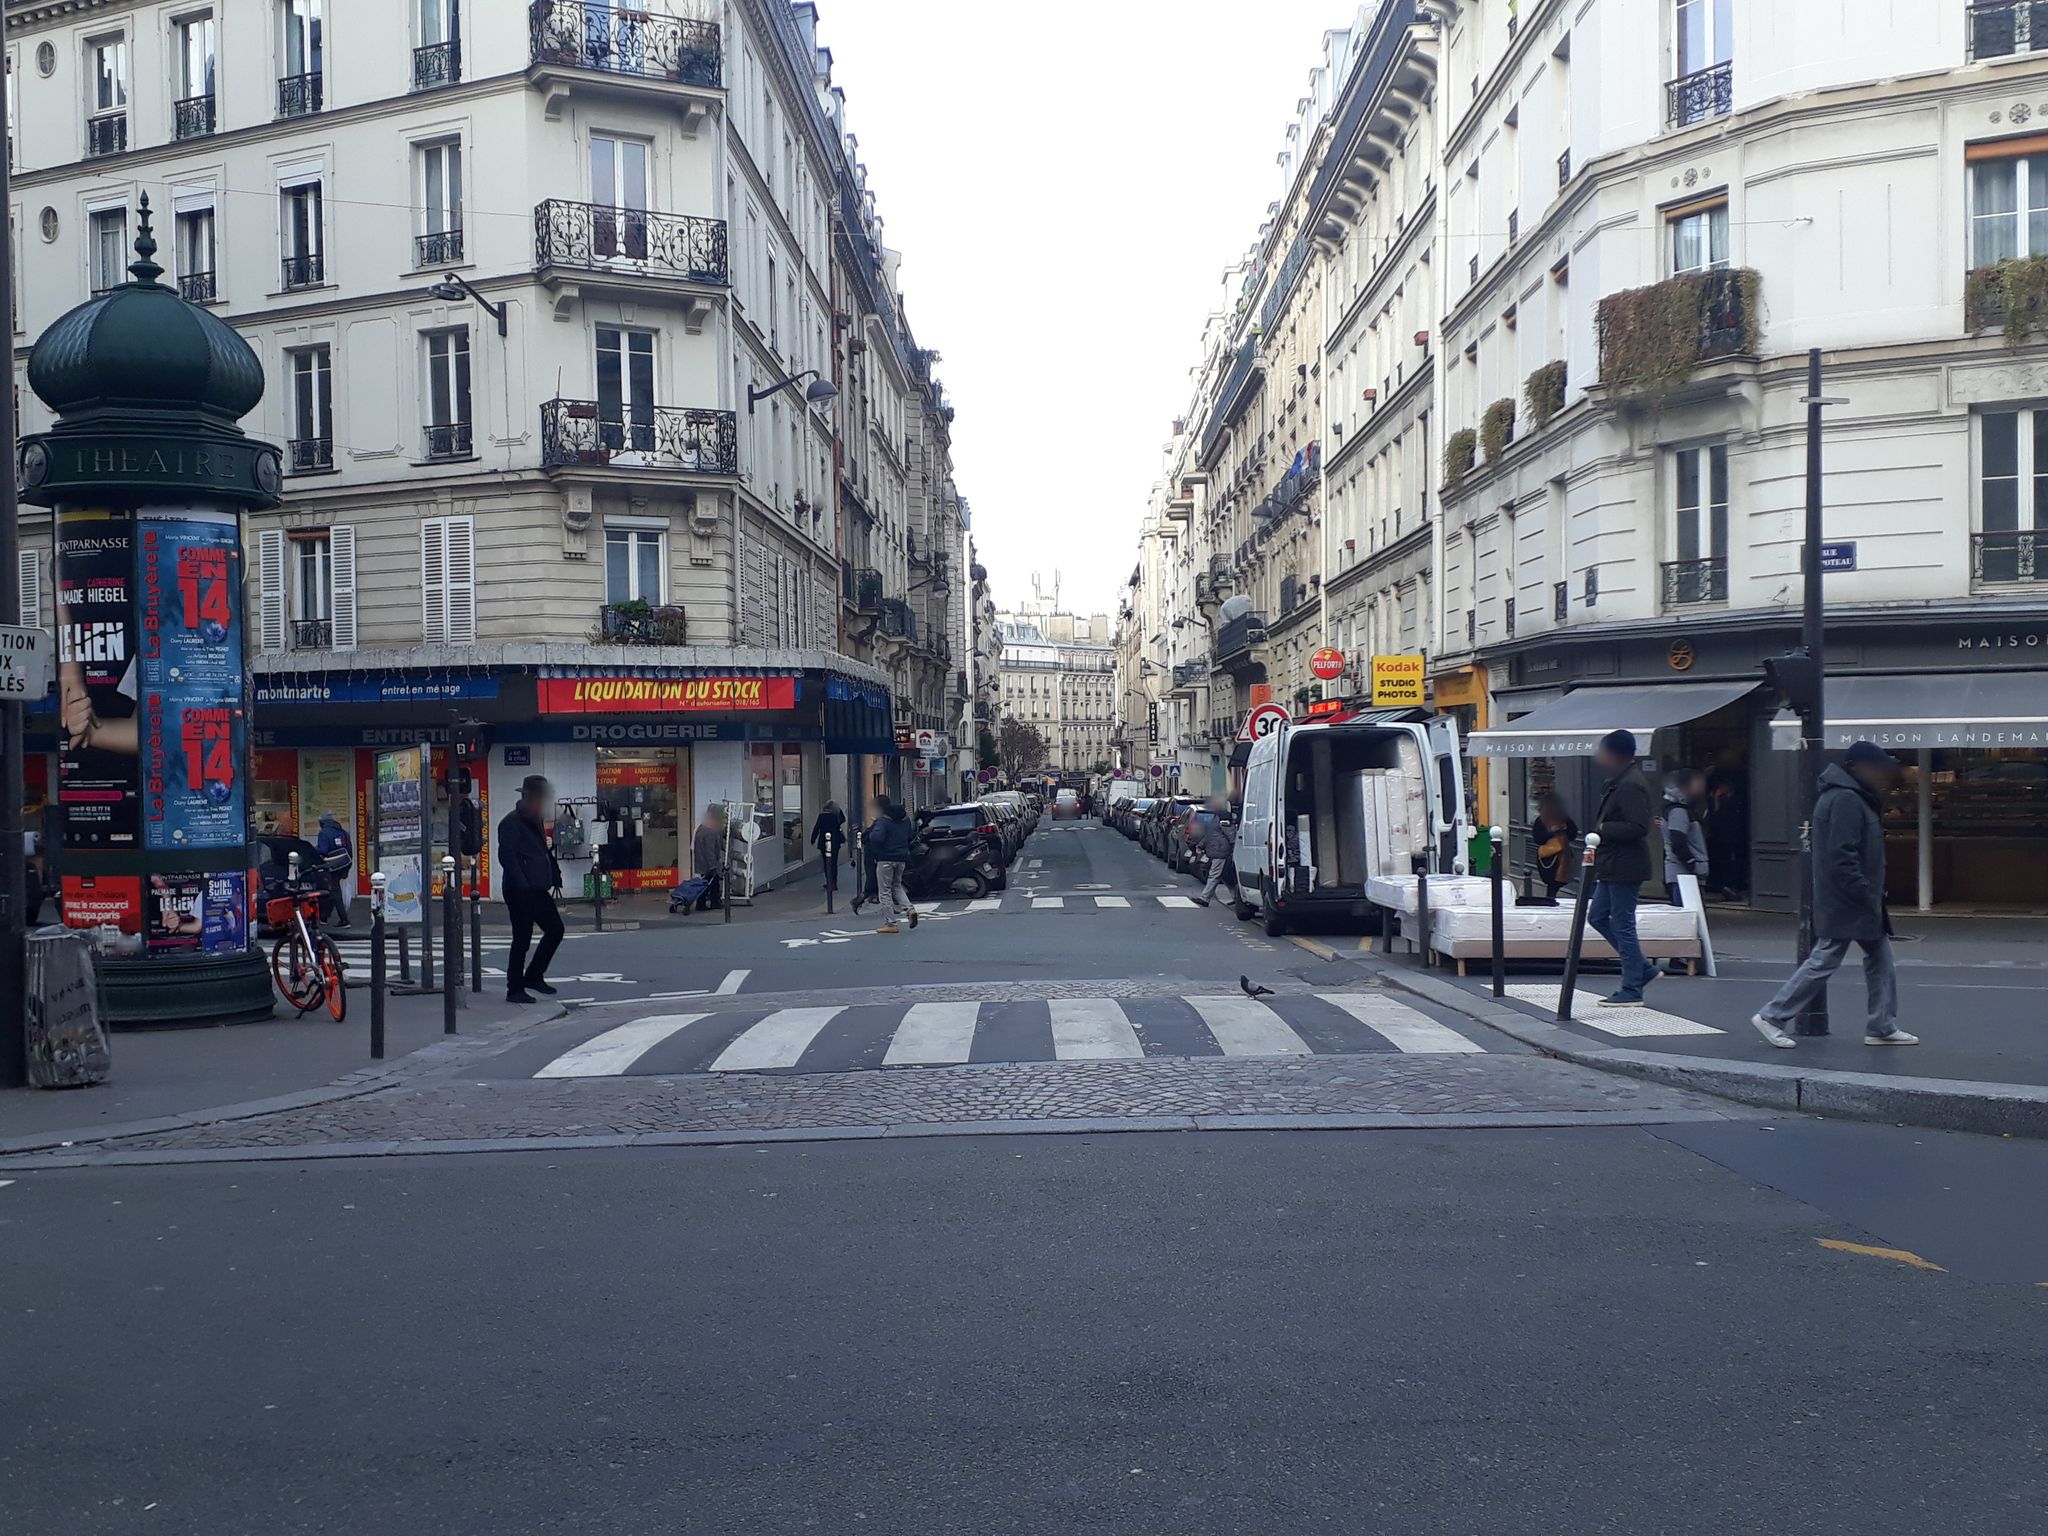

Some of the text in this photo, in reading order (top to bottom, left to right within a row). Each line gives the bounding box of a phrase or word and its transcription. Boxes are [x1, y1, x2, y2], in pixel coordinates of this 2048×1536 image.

[178, 547, 226, 561] COMME
[178, 561, 227, 578] EN
[88, 587, 128, 603] HIEGEL
[178, 578, 231, 629] 14
[59, 624, 72, 663] LE
[145, 635, 160, 659] La
[1313, 660, 1343, 670] PELFORTH
[1376, 662, 1420, 672] Kodak
[574, 680, 762, 702] LIQUIDATION DU STOCK
[1380, 680, 1416, 688] STUDIO
[1378, 690, 1418, 698] PHOTOS
[182, 708, 230, 721] COMME
[182, 722, 230, 739] EN
[573, 724, 719, 740] DROGUERIE
[1841, 733, 1921, 744] MAISON
[1486, 744, 1534, 752] MAISON
[182, 739, 234, 790] 14
[146, 798, 164, 821] La
[208, 888, 232, 897] Sulku
[89, 900, 128, 909] raccourci
[160, 898, 171, 912] LE
